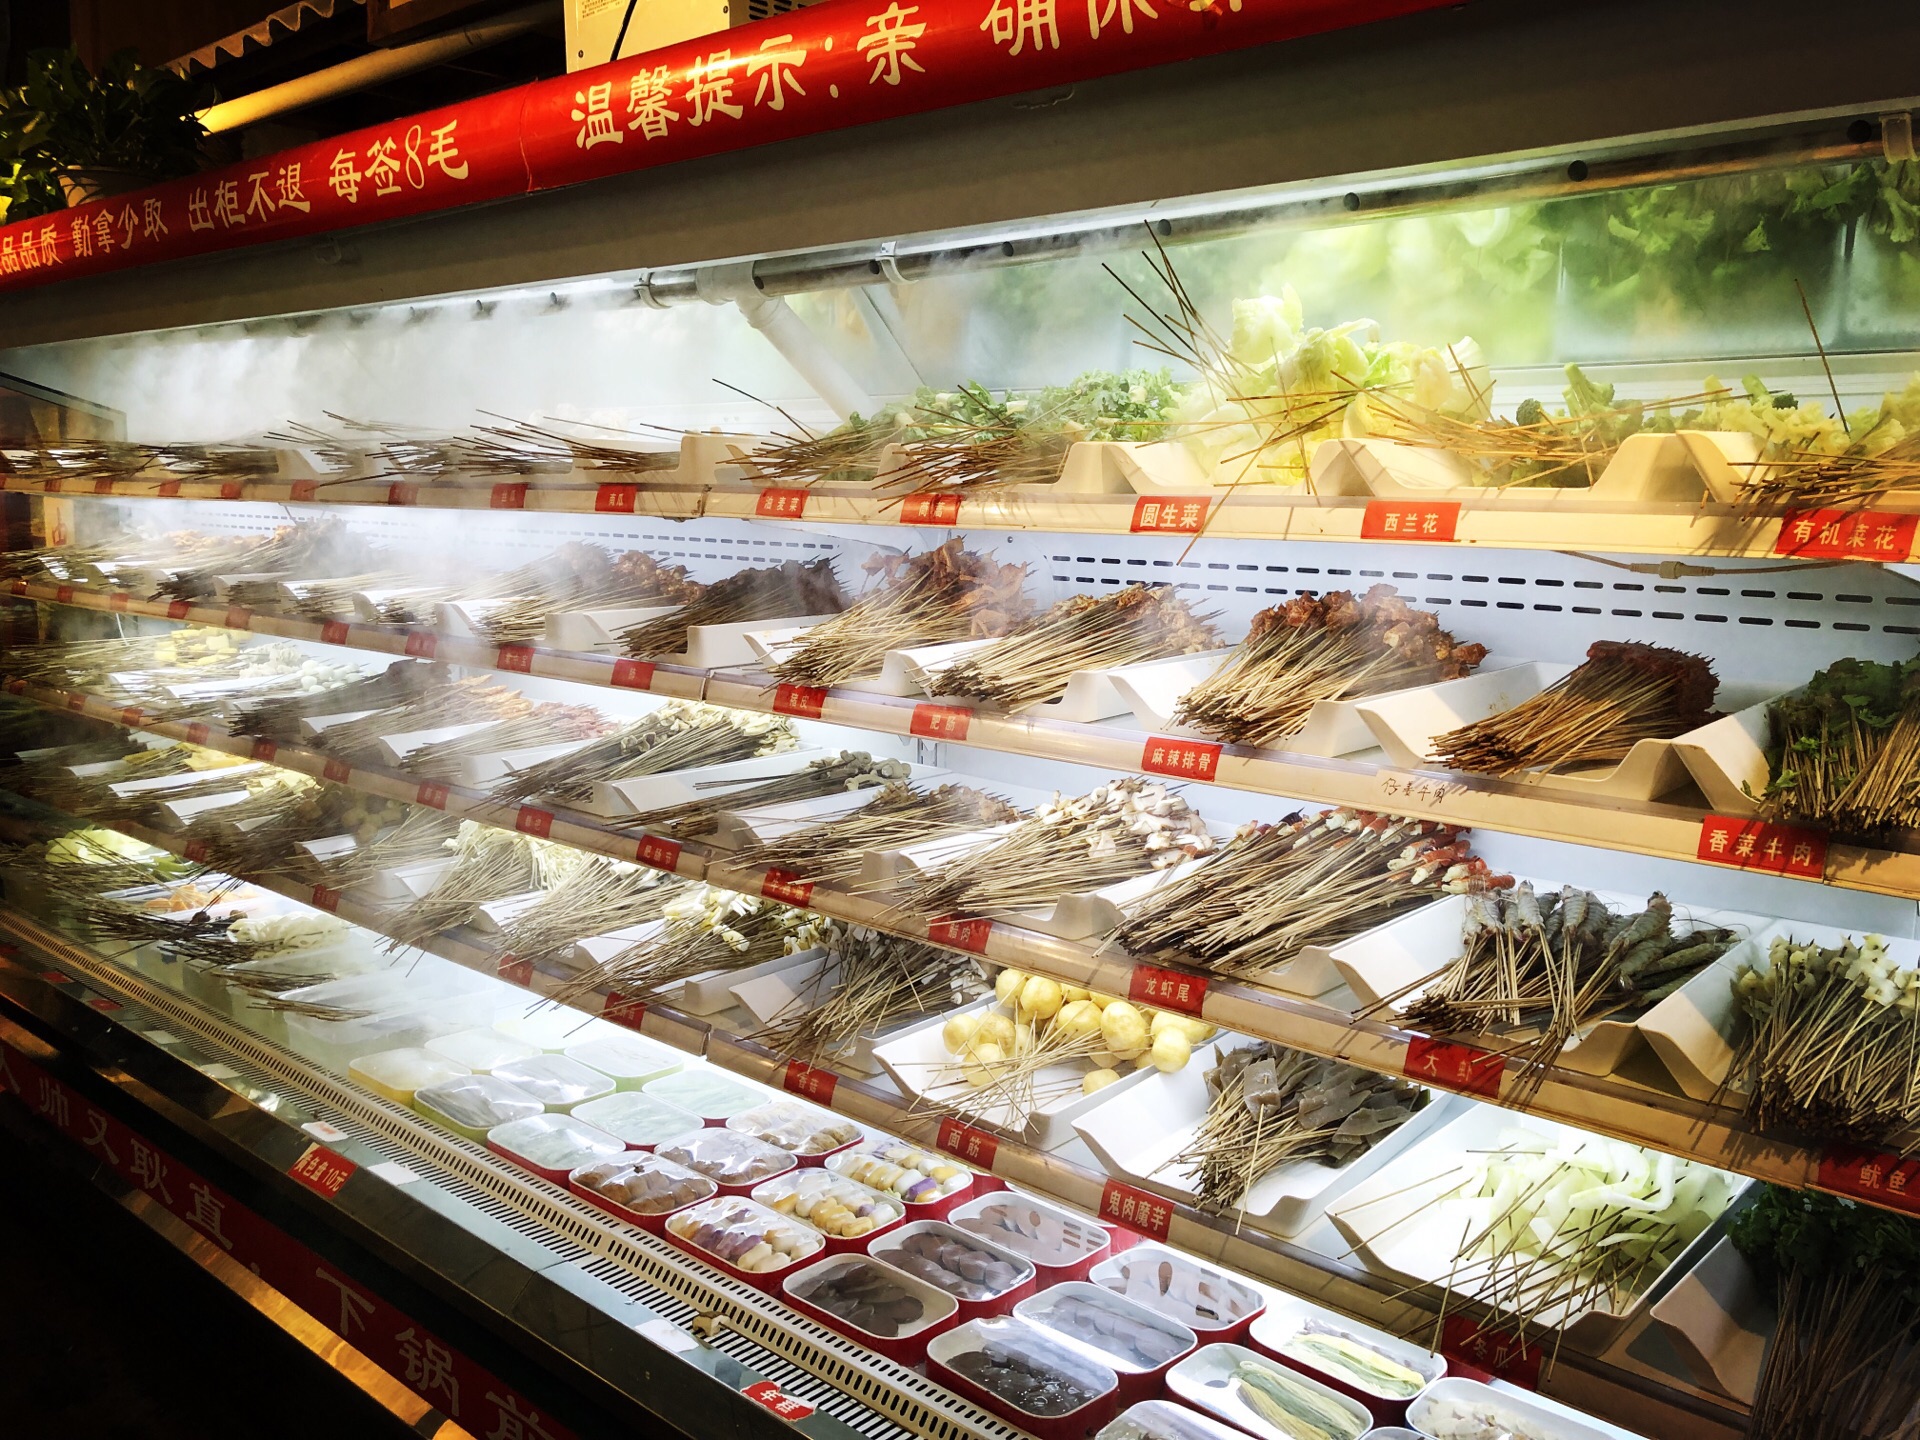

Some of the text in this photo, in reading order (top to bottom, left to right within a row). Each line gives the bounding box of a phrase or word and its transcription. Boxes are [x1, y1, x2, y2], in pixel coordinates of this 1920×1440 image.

[0, 223, 63, 275] 品品质
[71, 199, 168, 257] 勤拿少取
[188, 164, 311, 231] 出柜不退
[328, 118, 468, 203] 每签8毛
[608, 492, 624, 508] 南瓜
[763, 495, 799, 514] 油麦菜
[1139, 503, 1201, 529] 圆生菜
[1384, 512, 1439, 534] 西兰花
[1792, 519, 1898, 551] 有机菜花
[928, 715, 955, 733] 肥肠
[1151, 747, 1211, 772] 麻辣排骨
[1708, 828, 1813, 867] 香菜牛肉
[1144, 976, 1191, 1004] 龙虾尾
[1423, 1053, 1473, 1082] 大虾
[947, 1130, 982, 1158] 面筋
[322, 1167, 349, 1192] 10元
[1858, 1163, 1907, 1197] 鱿鱼
[1107, 1190, 1167, 1232] 鬼肉魔芋
[1472, 1337, 1509, 1369] 冬瓜
